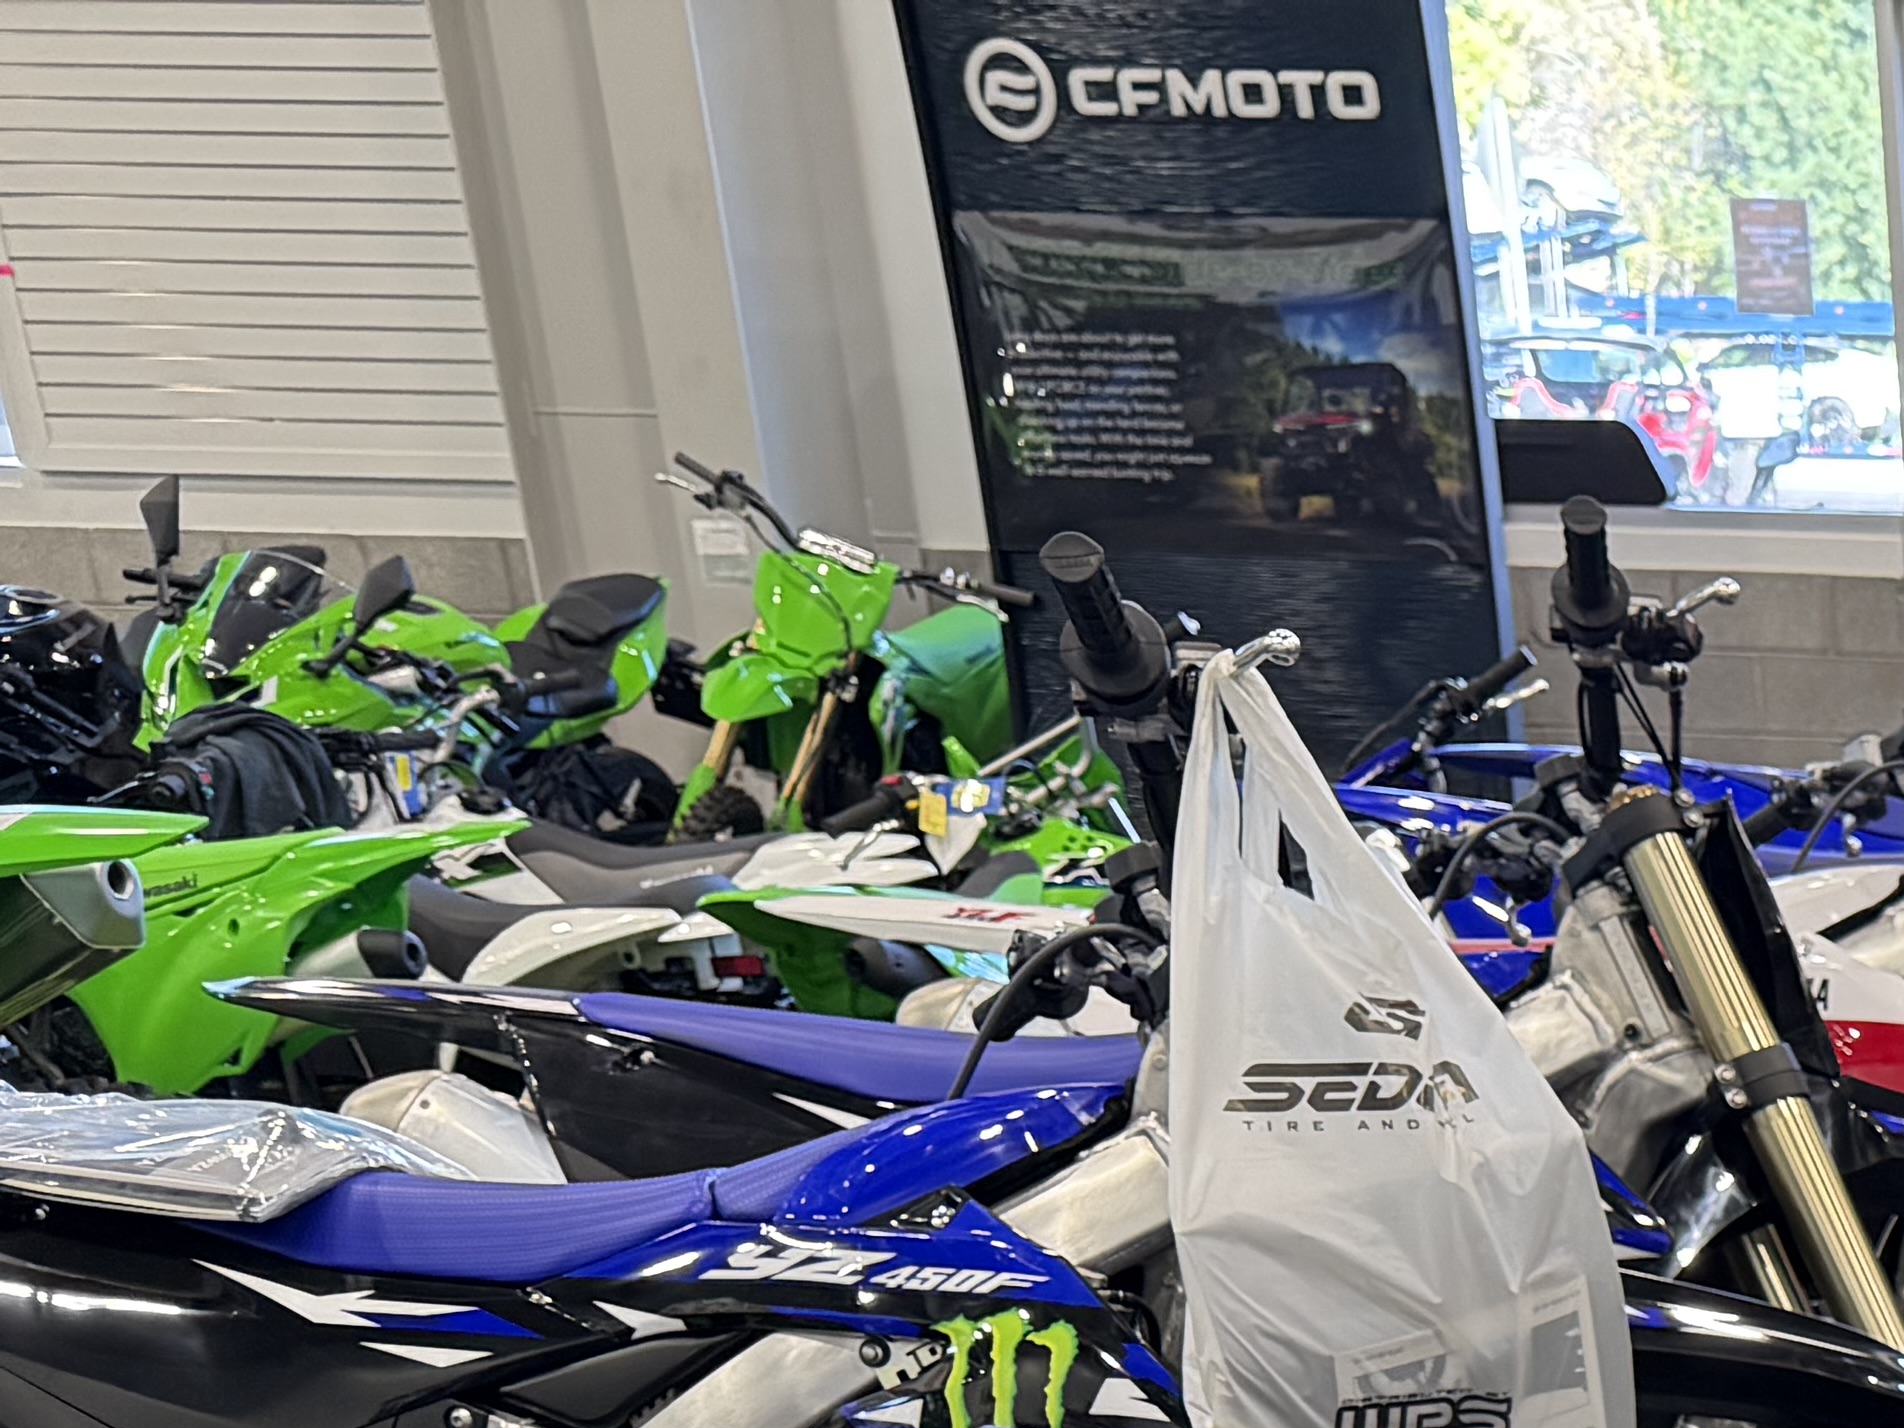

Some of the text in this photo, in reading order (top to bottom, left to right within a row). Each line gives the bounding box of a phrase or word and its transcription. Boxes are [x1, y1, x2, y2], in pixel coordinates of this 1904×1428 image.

[1068, 67, 1382, 121] CFMOTO
[1242, 1119, 1420, 1132] TIRE AND
